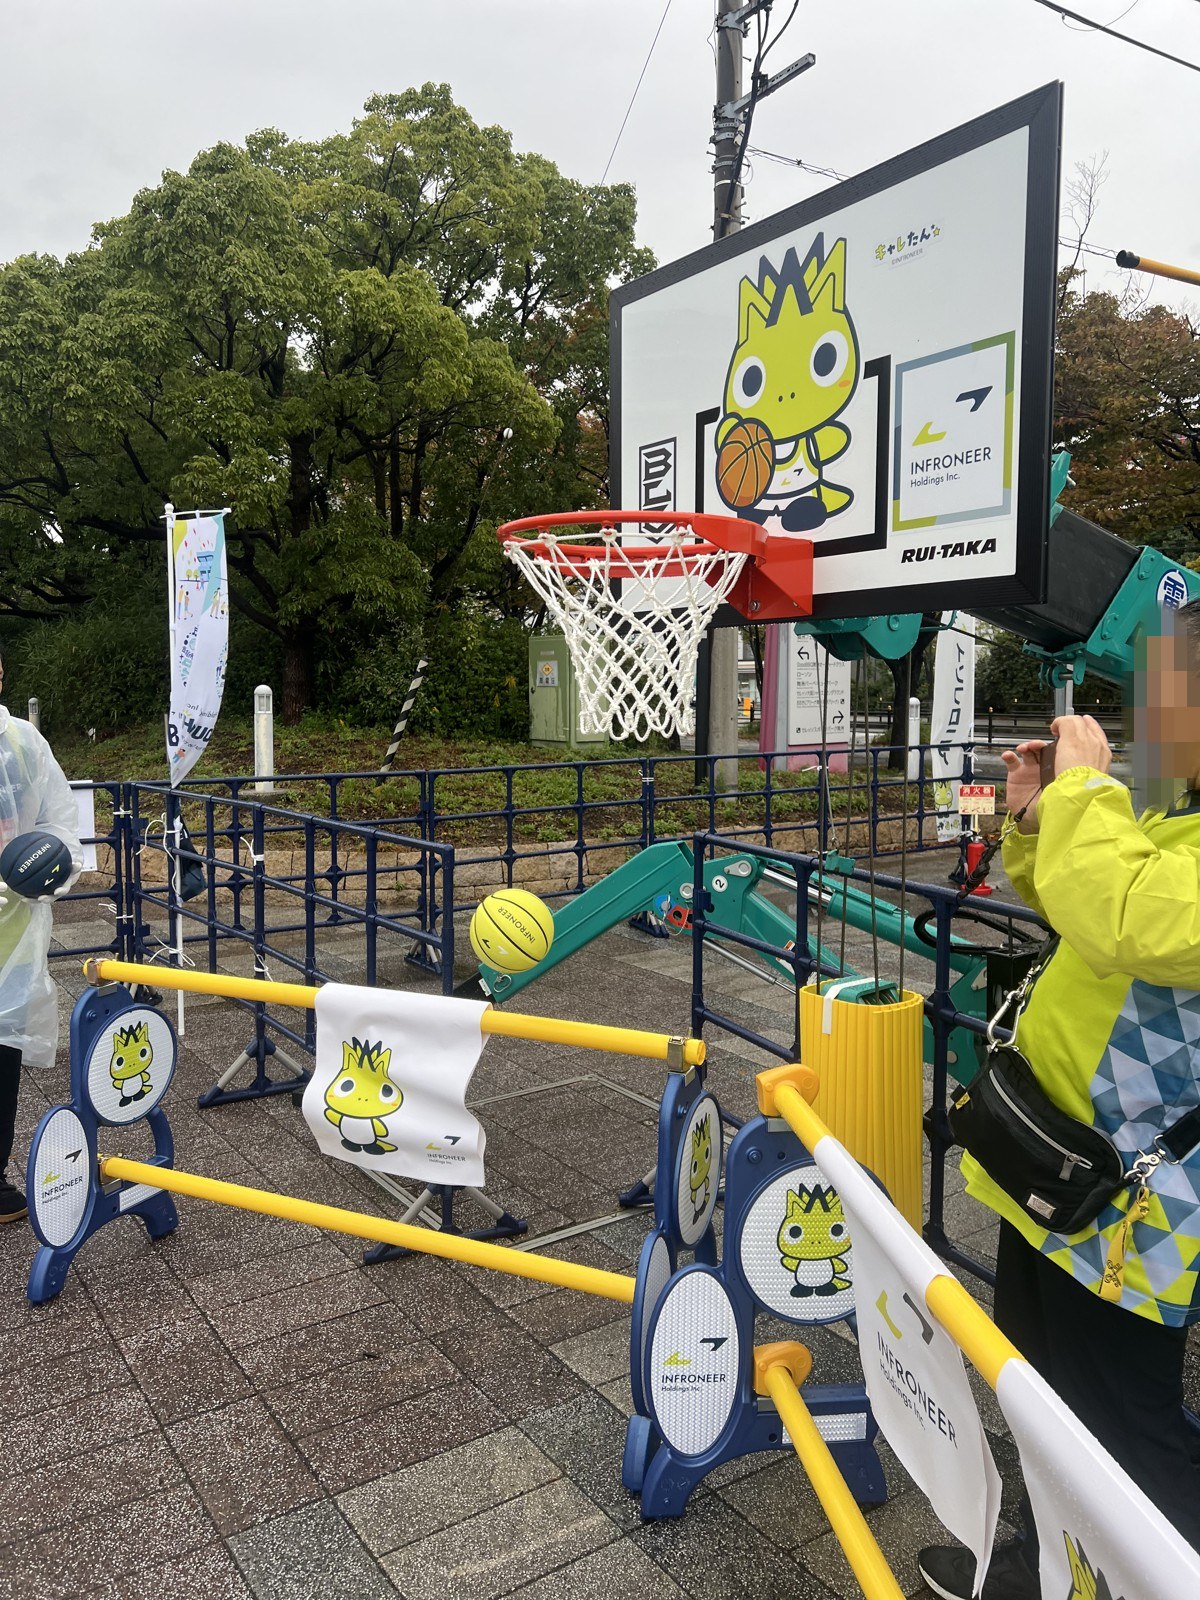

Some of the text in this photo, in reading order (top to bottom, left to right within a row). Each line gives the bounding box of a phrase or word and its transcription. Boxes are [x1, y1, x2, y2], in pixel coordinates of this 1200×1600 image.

[910, 446, 992, 475] INFRONEER
[910, 472, 961, 488] Holdings Inc.
[900, 538, 997, 564] RUI-TAKA
[962, 786, 991, 795] 消火器
[18, 843, 52, 874] INFRONEER
[715, 878, 725, 889] 2
[497, 906, 536, 944] INFRONEER
[427, 1153, 466, 1162] INFRONEER
[41, 1176, 83, 1199] INFRONEER
[661, 1373, 727, 1384] INFRONEER
[877, 1331, 958, 1449] INFRONEER
[879, 1359, 912, 1409] Holdings
